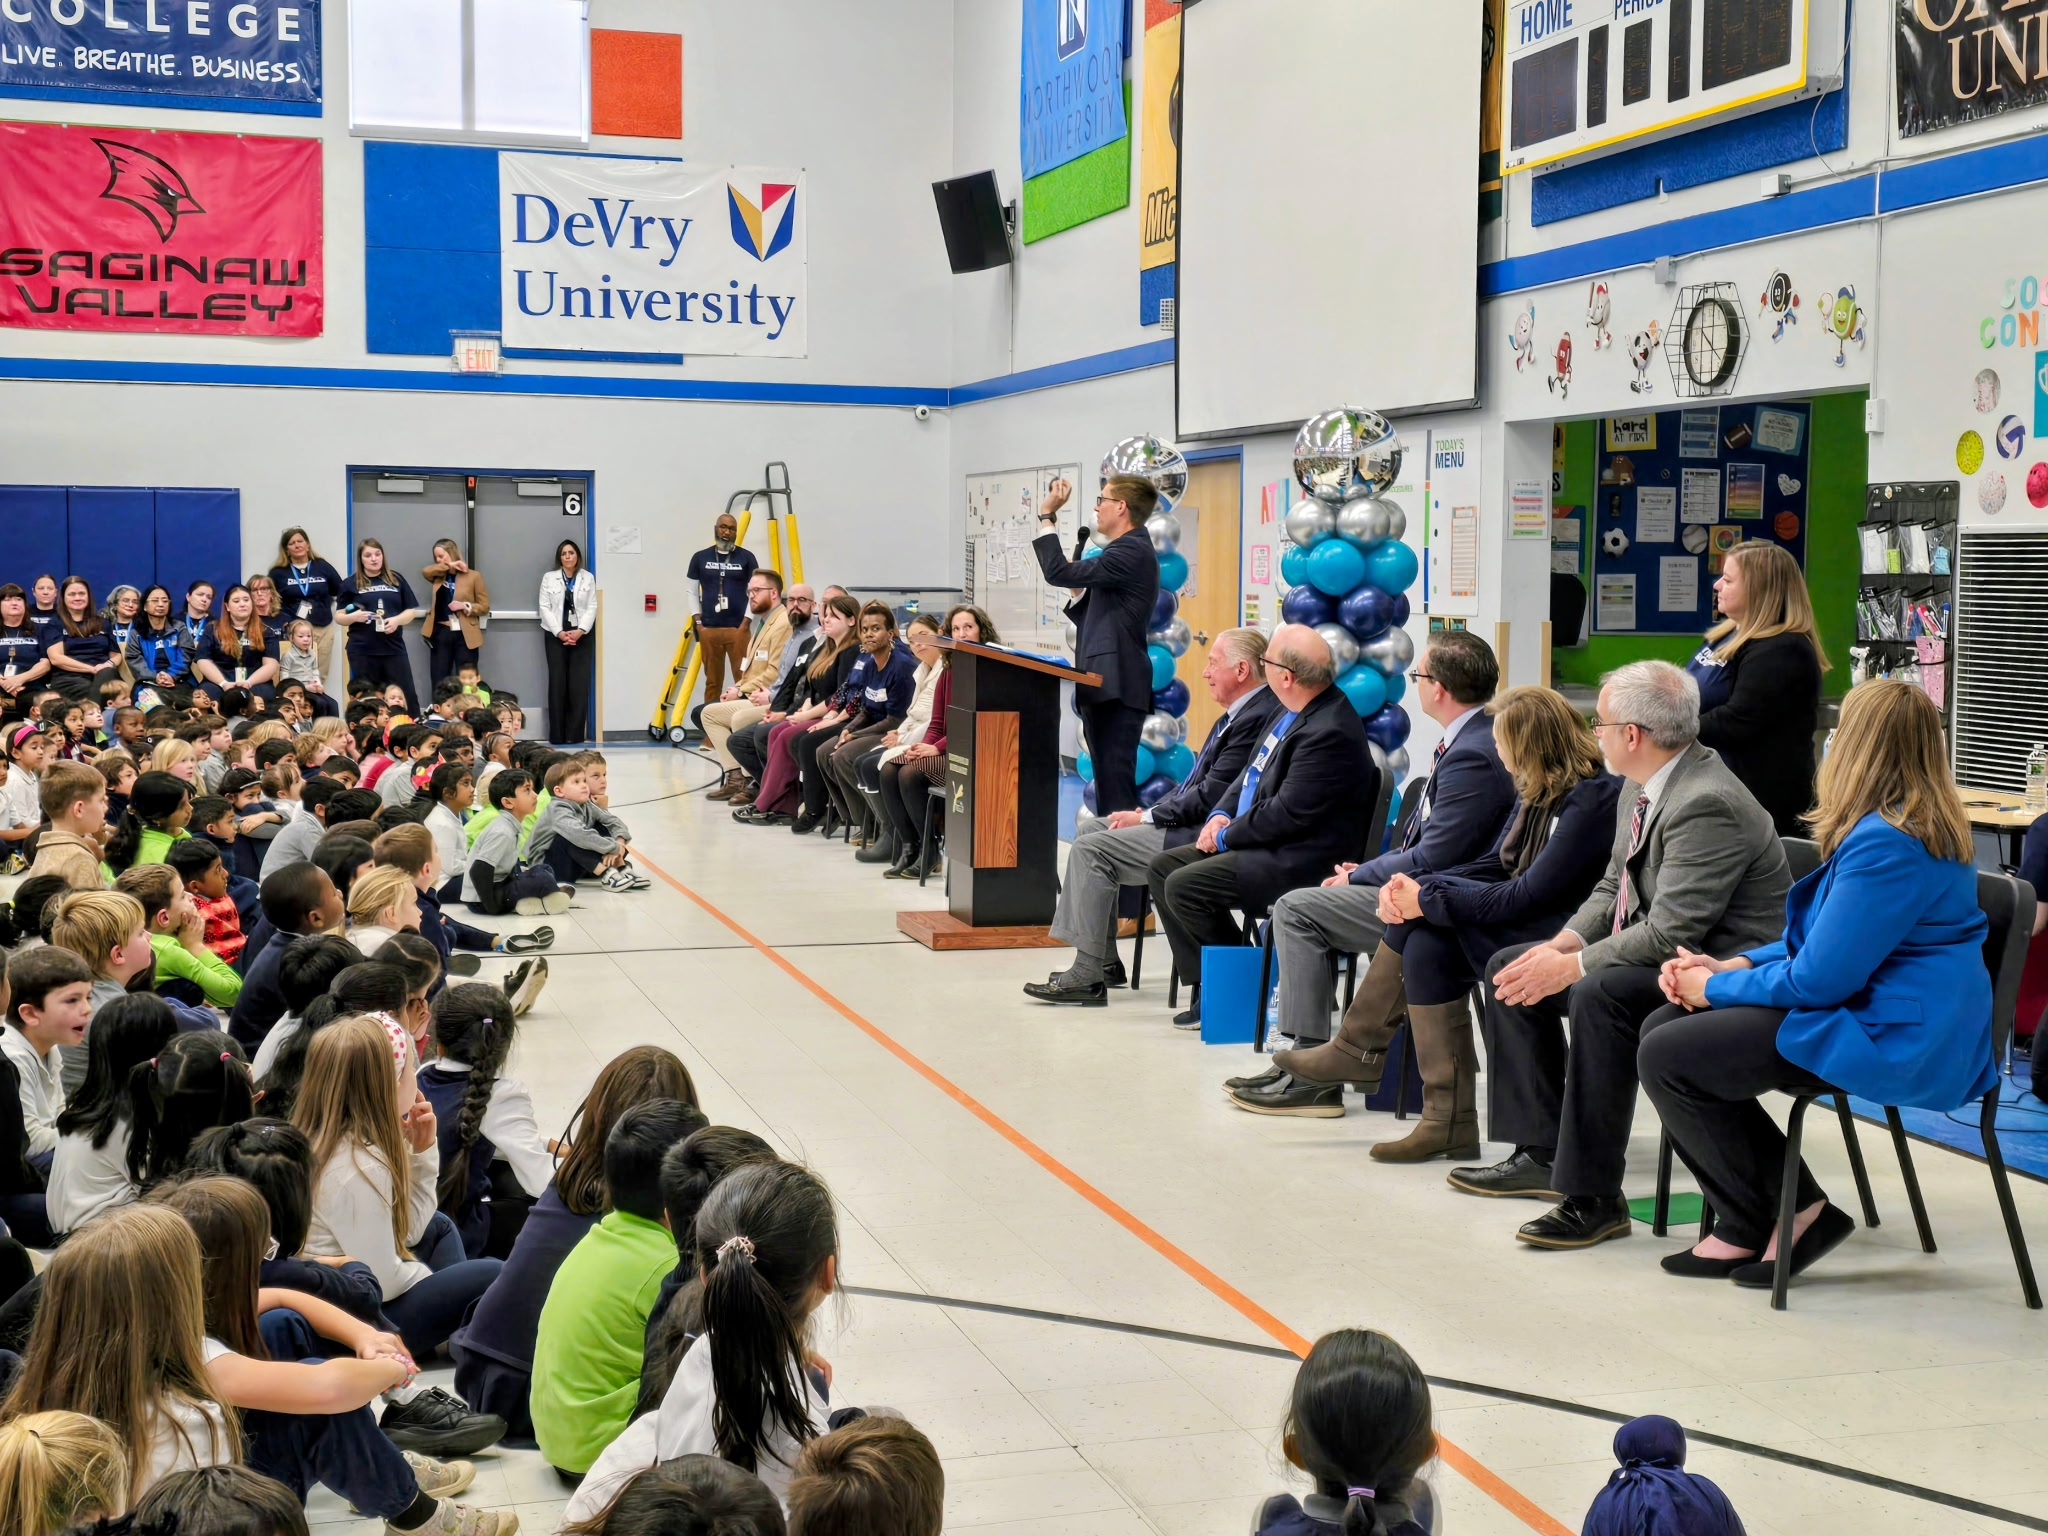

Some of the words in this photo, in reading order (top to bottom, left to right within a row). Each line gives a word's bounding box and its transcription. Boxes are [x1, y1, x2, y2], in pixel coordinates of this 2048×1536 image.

[1, 0, 301, 42] COLLEGE
[1520, 0, 1573, 45] HOME
[1, 44, 63, 68] LIVE.
[74, 46, 182, 76] BREATHE.
[192, 55, 307, 84] BUSINESS.
[511, 193, 693, 267] DeVry
[0, 247, 306, 287] SAGINAW
[15, 284, 293, 322] VALLEY
[513, 269, 796, 340] University
[465, 348, 493, 370] EXIT
[1436, 438, 1465, 452] TODAY'S
[1613, 418, 1647, 433] hard
[1435, 451, 1465, 469] MENU
[565, 493, 580, 514] 6
